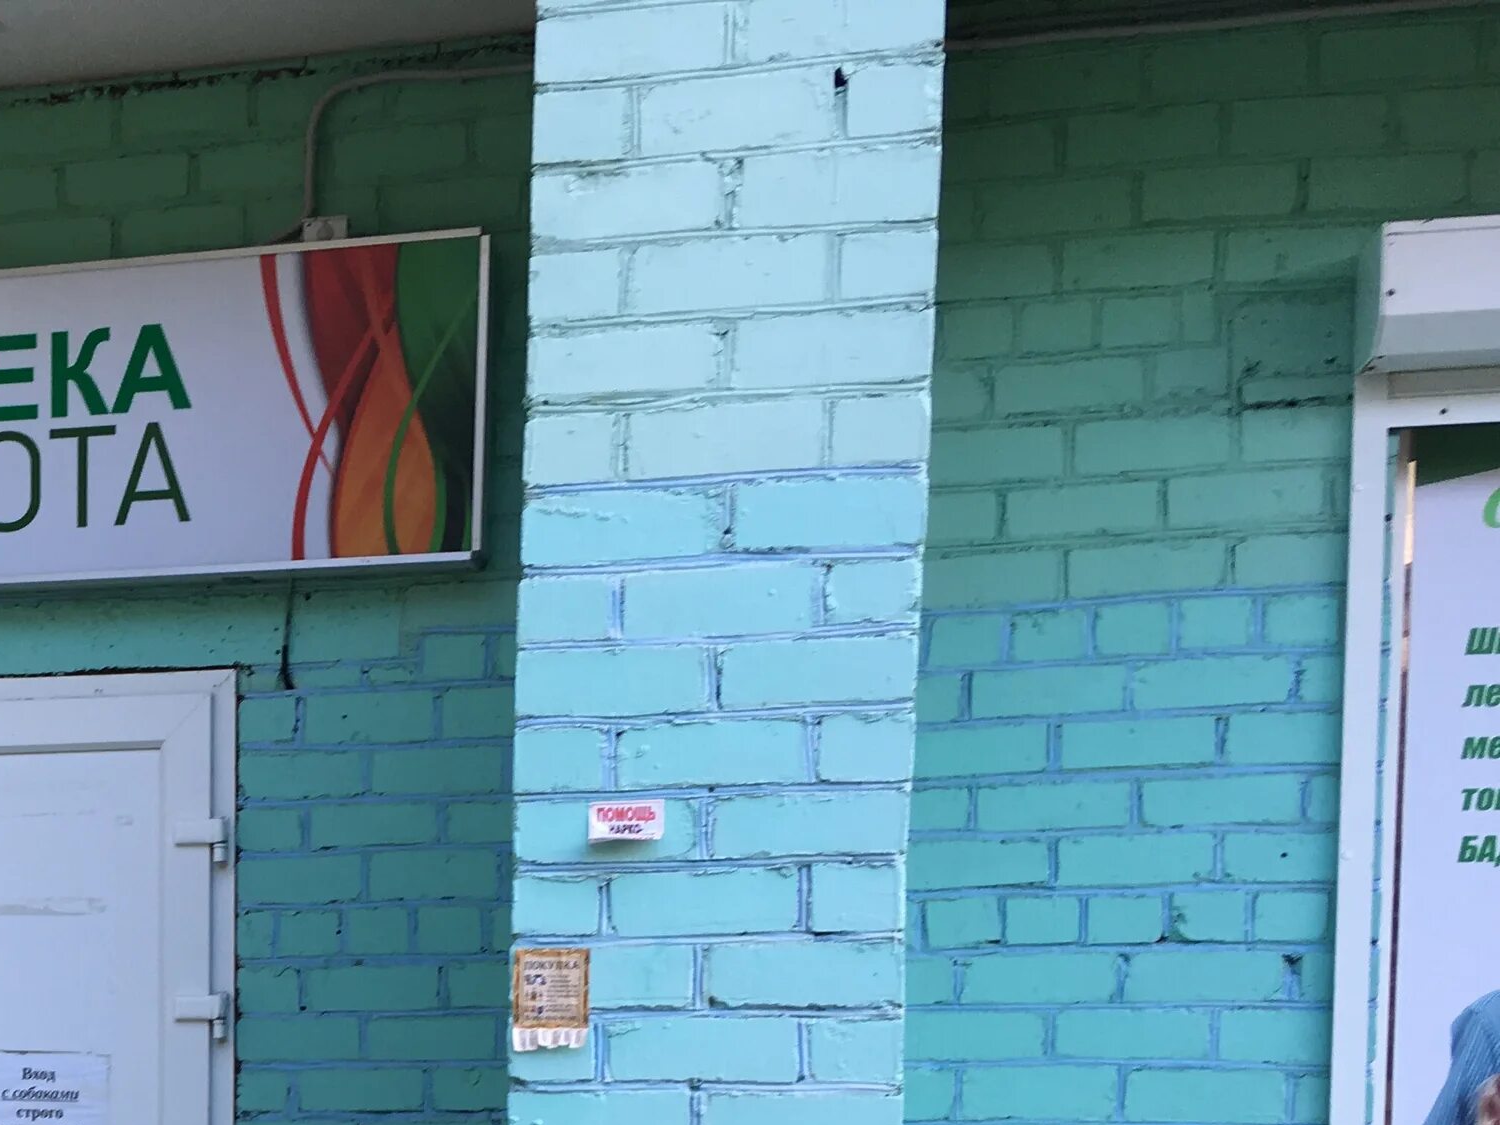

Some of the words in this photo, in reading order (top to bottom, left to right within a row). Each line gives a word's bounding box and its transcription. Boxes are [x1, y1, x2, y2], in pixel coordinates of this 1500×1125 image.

[1464, 627, 1500, 655] Ш
[596, 806, 656, 823] ПОМОЩЬ
[22, 1067, 56, 1083] Вход
[1, 1089, 10, 1100] с
[12, 1085, 79, 1101] собаками
[16, 1108, 64, 1121] строго
